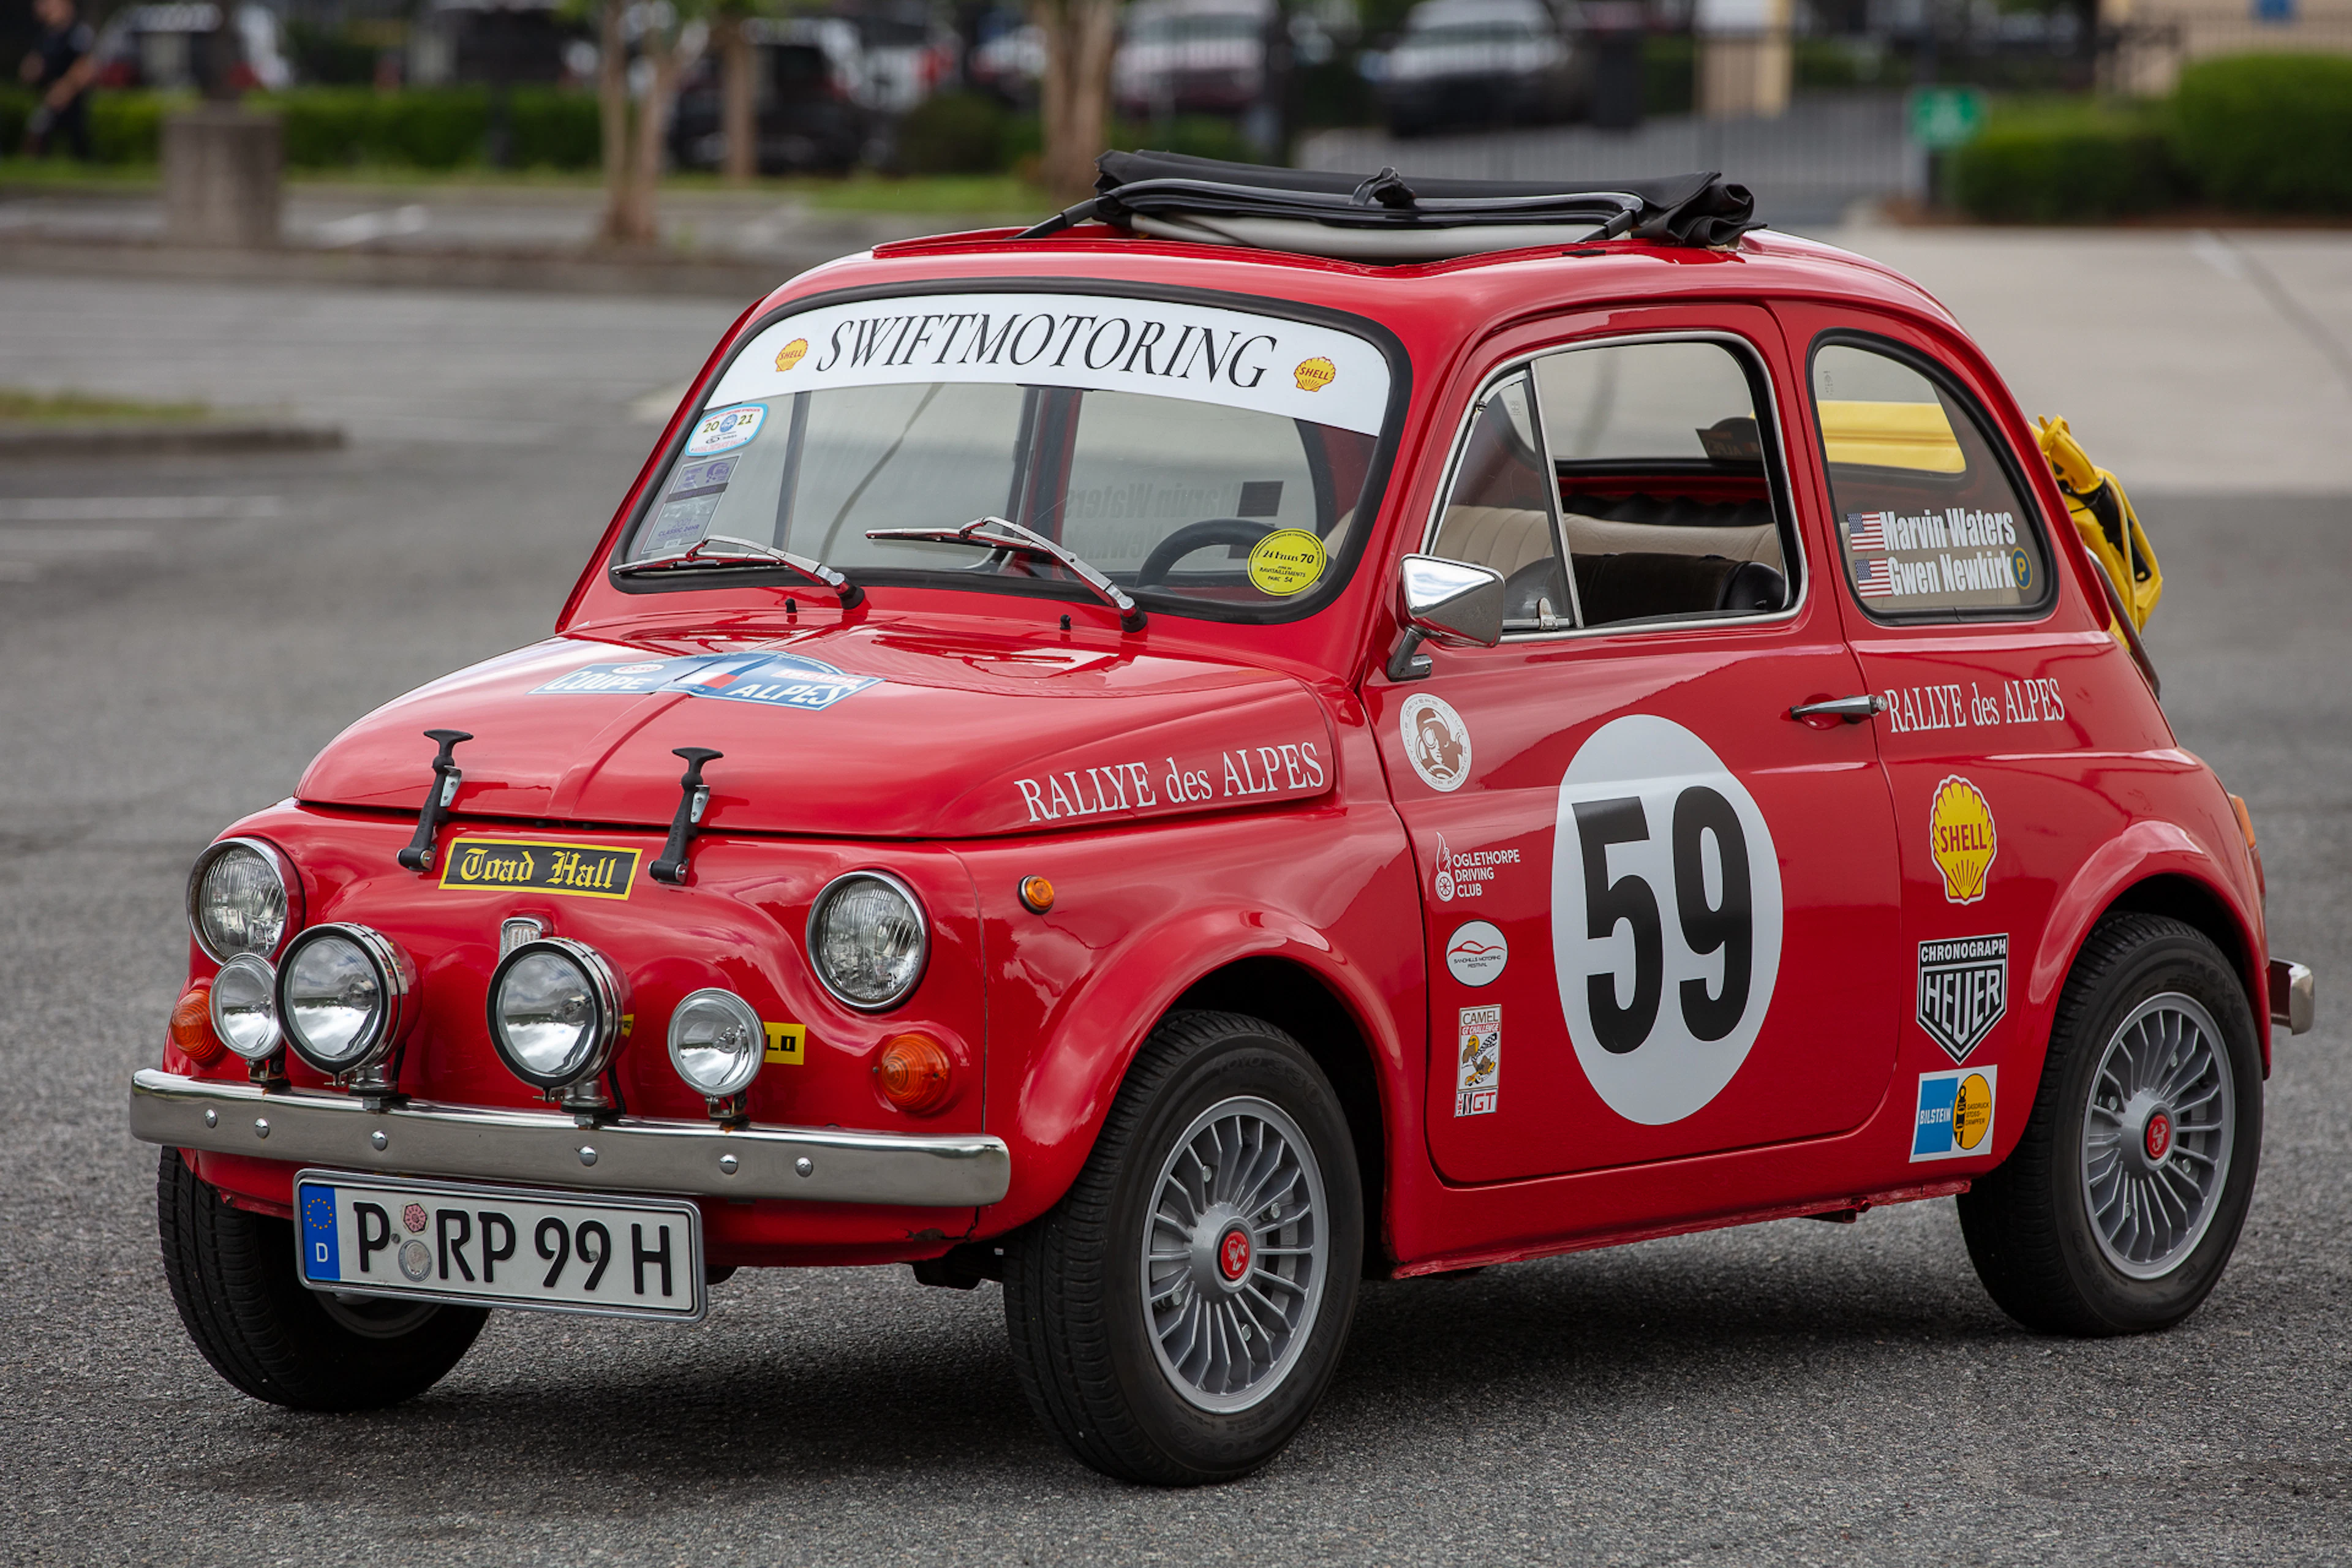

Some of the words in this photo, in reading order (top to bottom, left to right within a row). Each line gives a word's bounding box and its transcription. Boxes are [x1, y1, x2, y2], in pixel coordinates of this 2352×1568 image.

[778, 349, 802, 360] SHELL
[816, 312, 1277, 388] SWIFTMOTORING
[1299, 367, 1329, 380] SHELL
[703, 421, 720, 434] 20
[737, 413, 753, 426] 21
[1879, 509, 1948, 551] Marvin
[1945, 508, 2016, 547] Waters
[1300, 553, 1314, 564] 70
[2016, 557, 2026, 581] P
[1887, 556, 1941, 596] Gwen
[1939, 551, 2017, 592] Newkirk
[544, 671, 654, 690] COUPE
[725, 684, 858, 704] ALPES
[1884, 684, 1967, 733] RALLYE
[1971, 682, 2000, 726] des
[2003, 677, 2065, 724] ALPES
[1014, 761, 1157, 823] RALLYE
[1164, 756, 1213, 804] des
[1223, 741, 1325, 797] ALPES
[1940, 823, 1988, 853] SHELL
[461, 847, 535, 883] Toad
[546, 850, 618, 891] Hall
[1452, 849, 1521, 868] OGLETHORPE
[1455, 867, 1494, 883] DRIVING
[1457, 883, 1483, 898] CLUB
[1572, 785, 1753, 1055] 59
[1921, 938, 2007, 962] CHRONOGRAPH
[1925, 968, 2001, 1046] HEUER
[1463, 1011, 1498, 1025] CAMEL
[1472, 1091, 1496, 1112] GT
[1919, 1107, 1951, 1126] BILSTEIN
[315, 1243, 329, 1262] D
[353, 1201, 390, 1273] P
[436, 1209, 516, 1283] RP
[535, 1217, 611, 1291] 99
[631, 1223, 673, 1297] H
